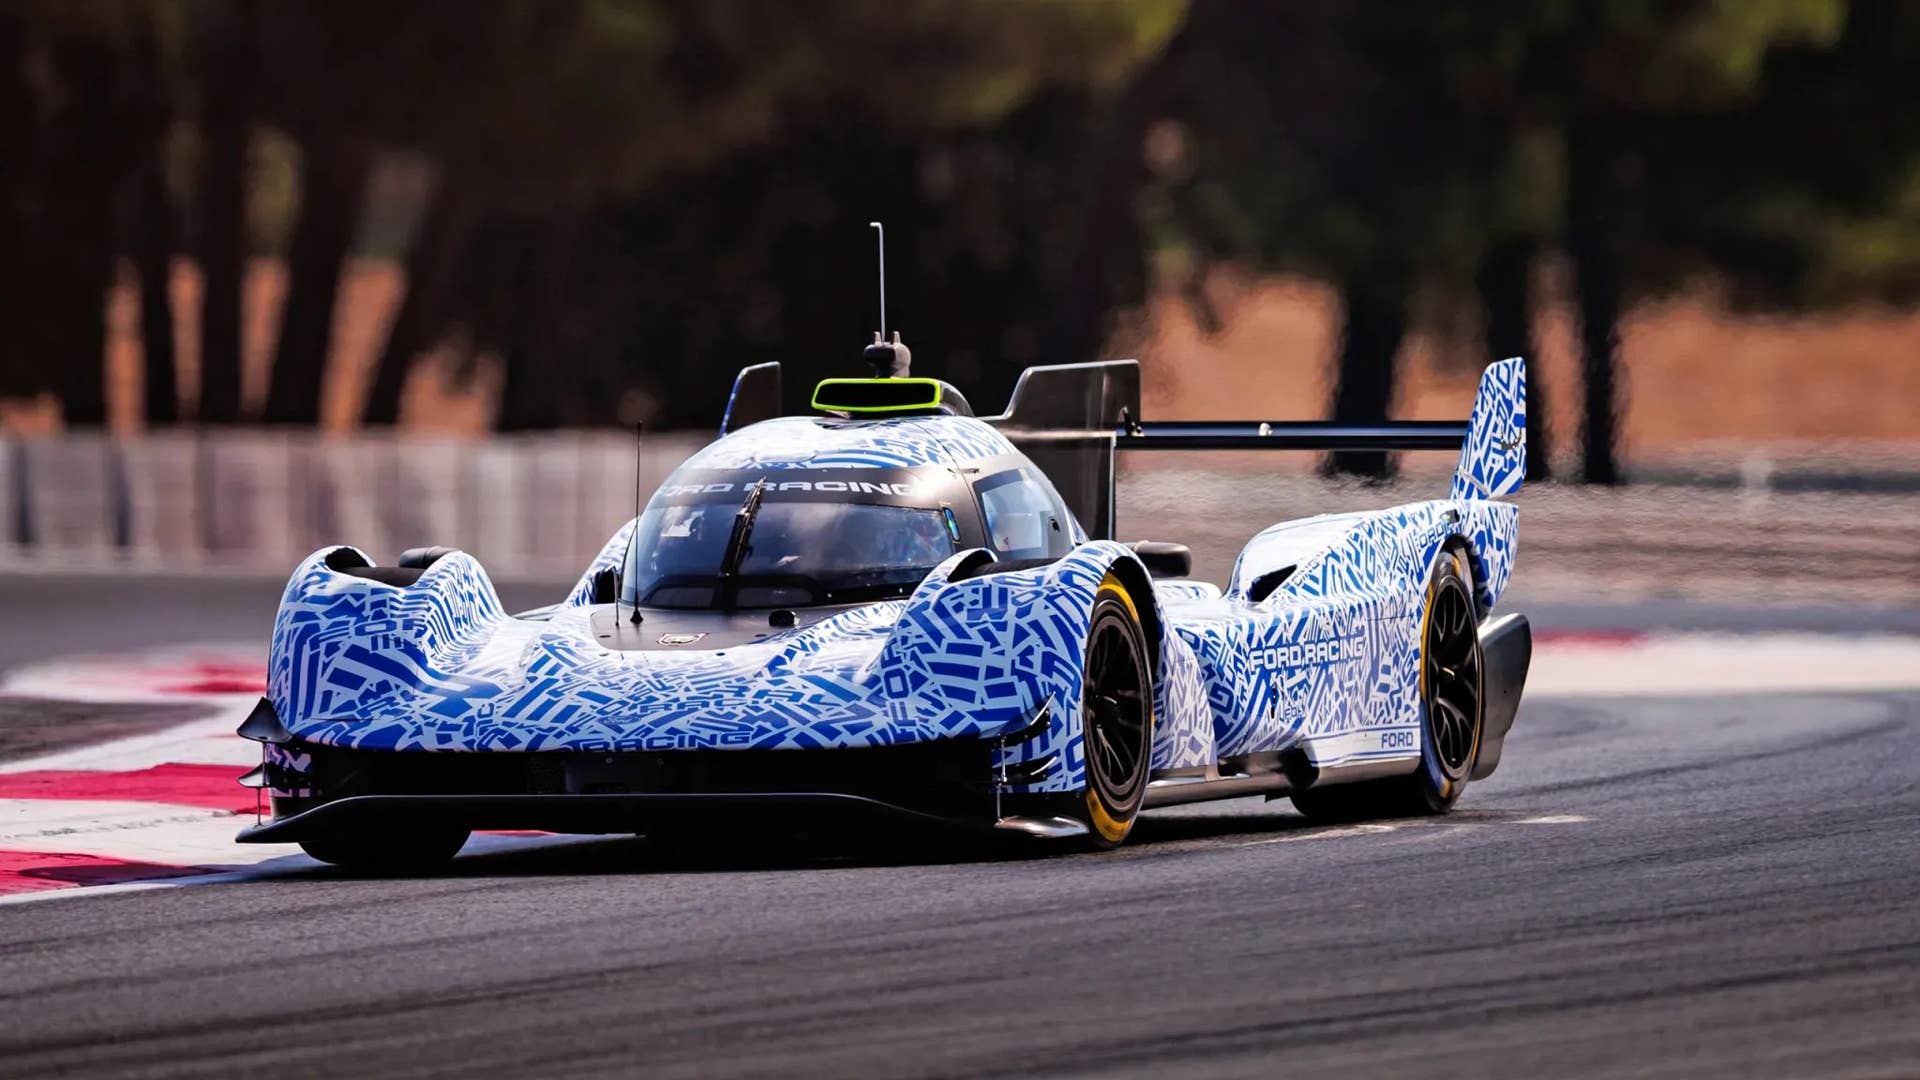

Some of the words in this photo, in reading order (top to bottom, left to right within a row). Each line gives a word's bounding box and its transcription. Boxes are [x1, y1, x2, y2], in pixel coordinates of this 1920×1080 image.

[659, 483, 735, 496] ORD
[743, 481, 915, 495] RACING
[1249, 646, 1301, 672] FORD
[1303, 639, 1365, 665] RACING
[1381, 731, 1414, 749] FORD
